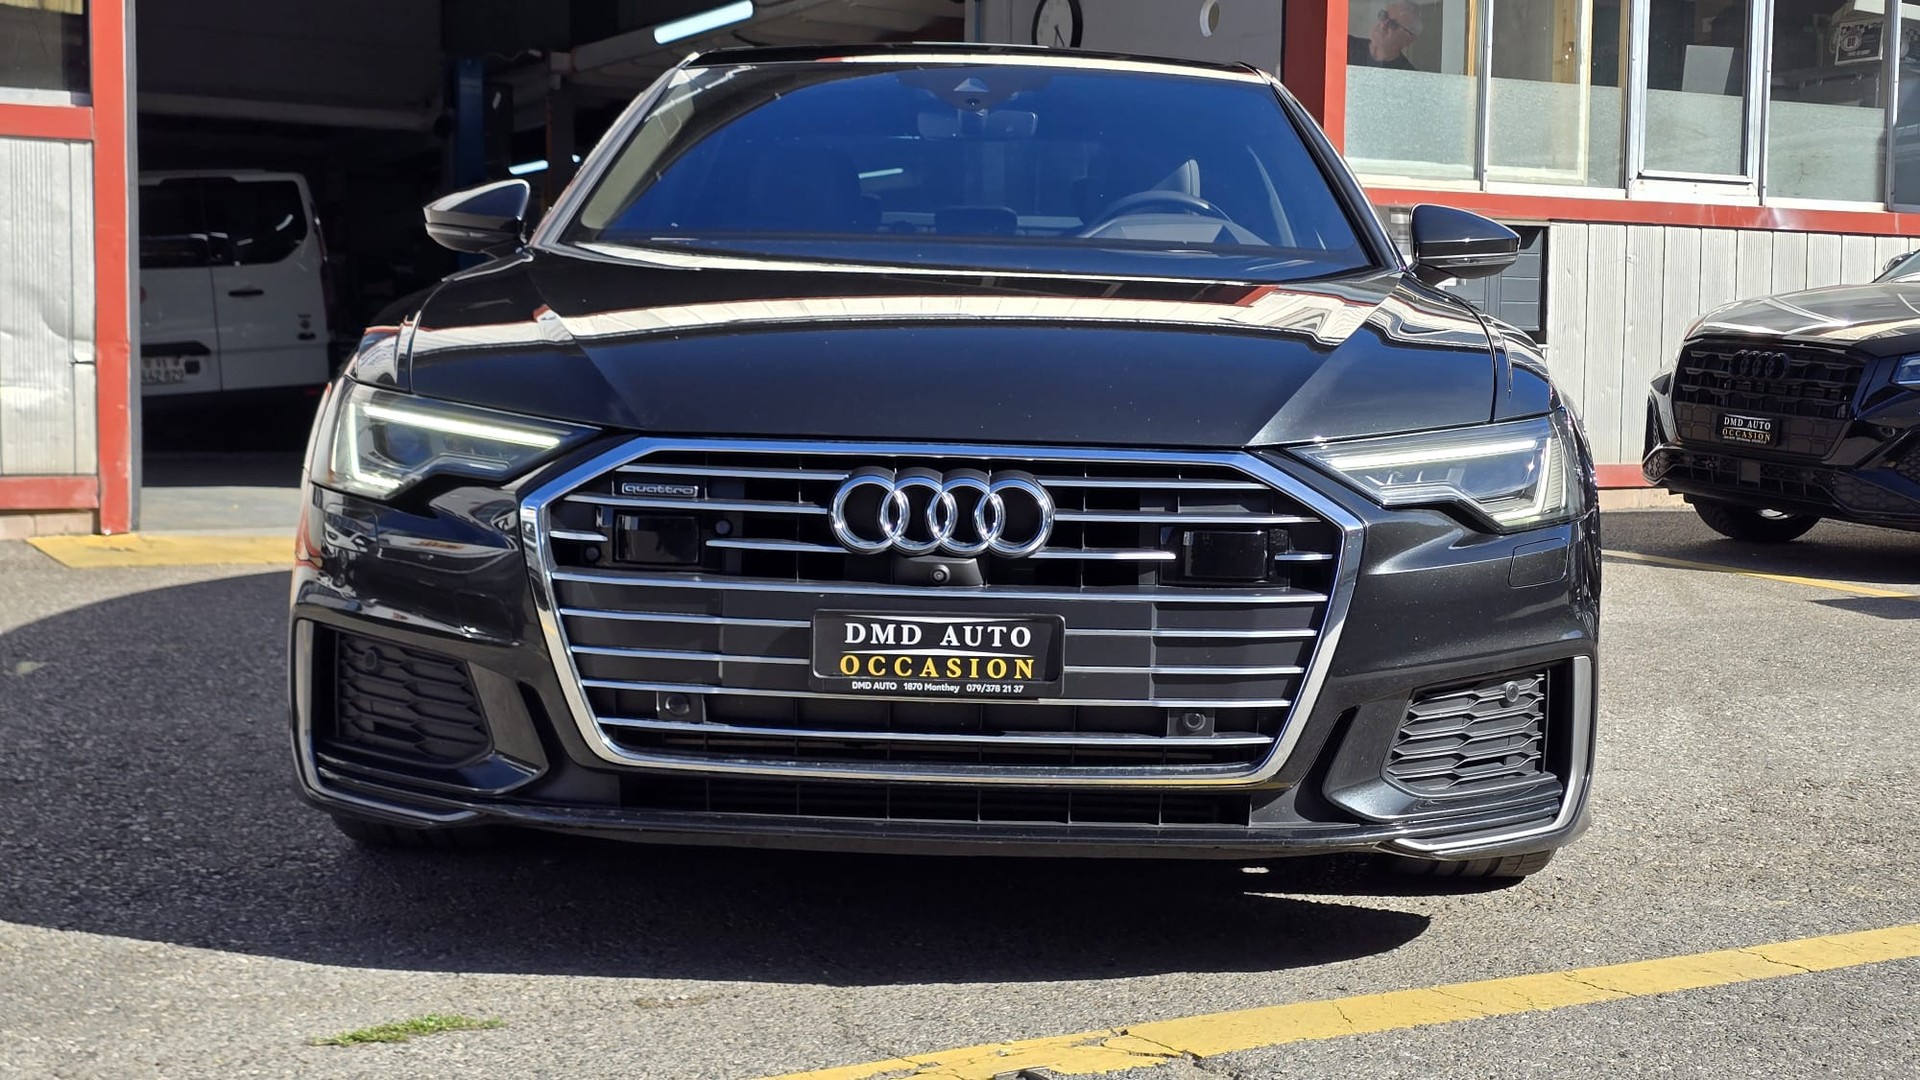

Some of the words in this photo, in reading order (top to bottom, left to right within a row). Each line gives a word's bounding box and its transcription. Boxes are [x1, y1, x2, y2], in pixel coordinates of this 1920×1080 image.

[1724, 417, 1743, 427] DMD
[1747, 420, 1771, 430] AUTO
[1722, 428, 1771, 441] OCCASION
[625, 485, 694, 494] quattro
[844, 623, 922, 646] DMD
[940, 625, 1031, 648] AUTO
[840, 655, 1034, 679] OCCASION
[852, 681, 871, 690] DMD
[873, 682, 897, 690] AUTO
[903, 682, 923, 691] 1870
[924, 683, 960, 694] Monthey
[966, 683, 1001, 693] 079/378
[1002, 685, 1012, 693] 21
[1013, 685, 1024, 693] 37
